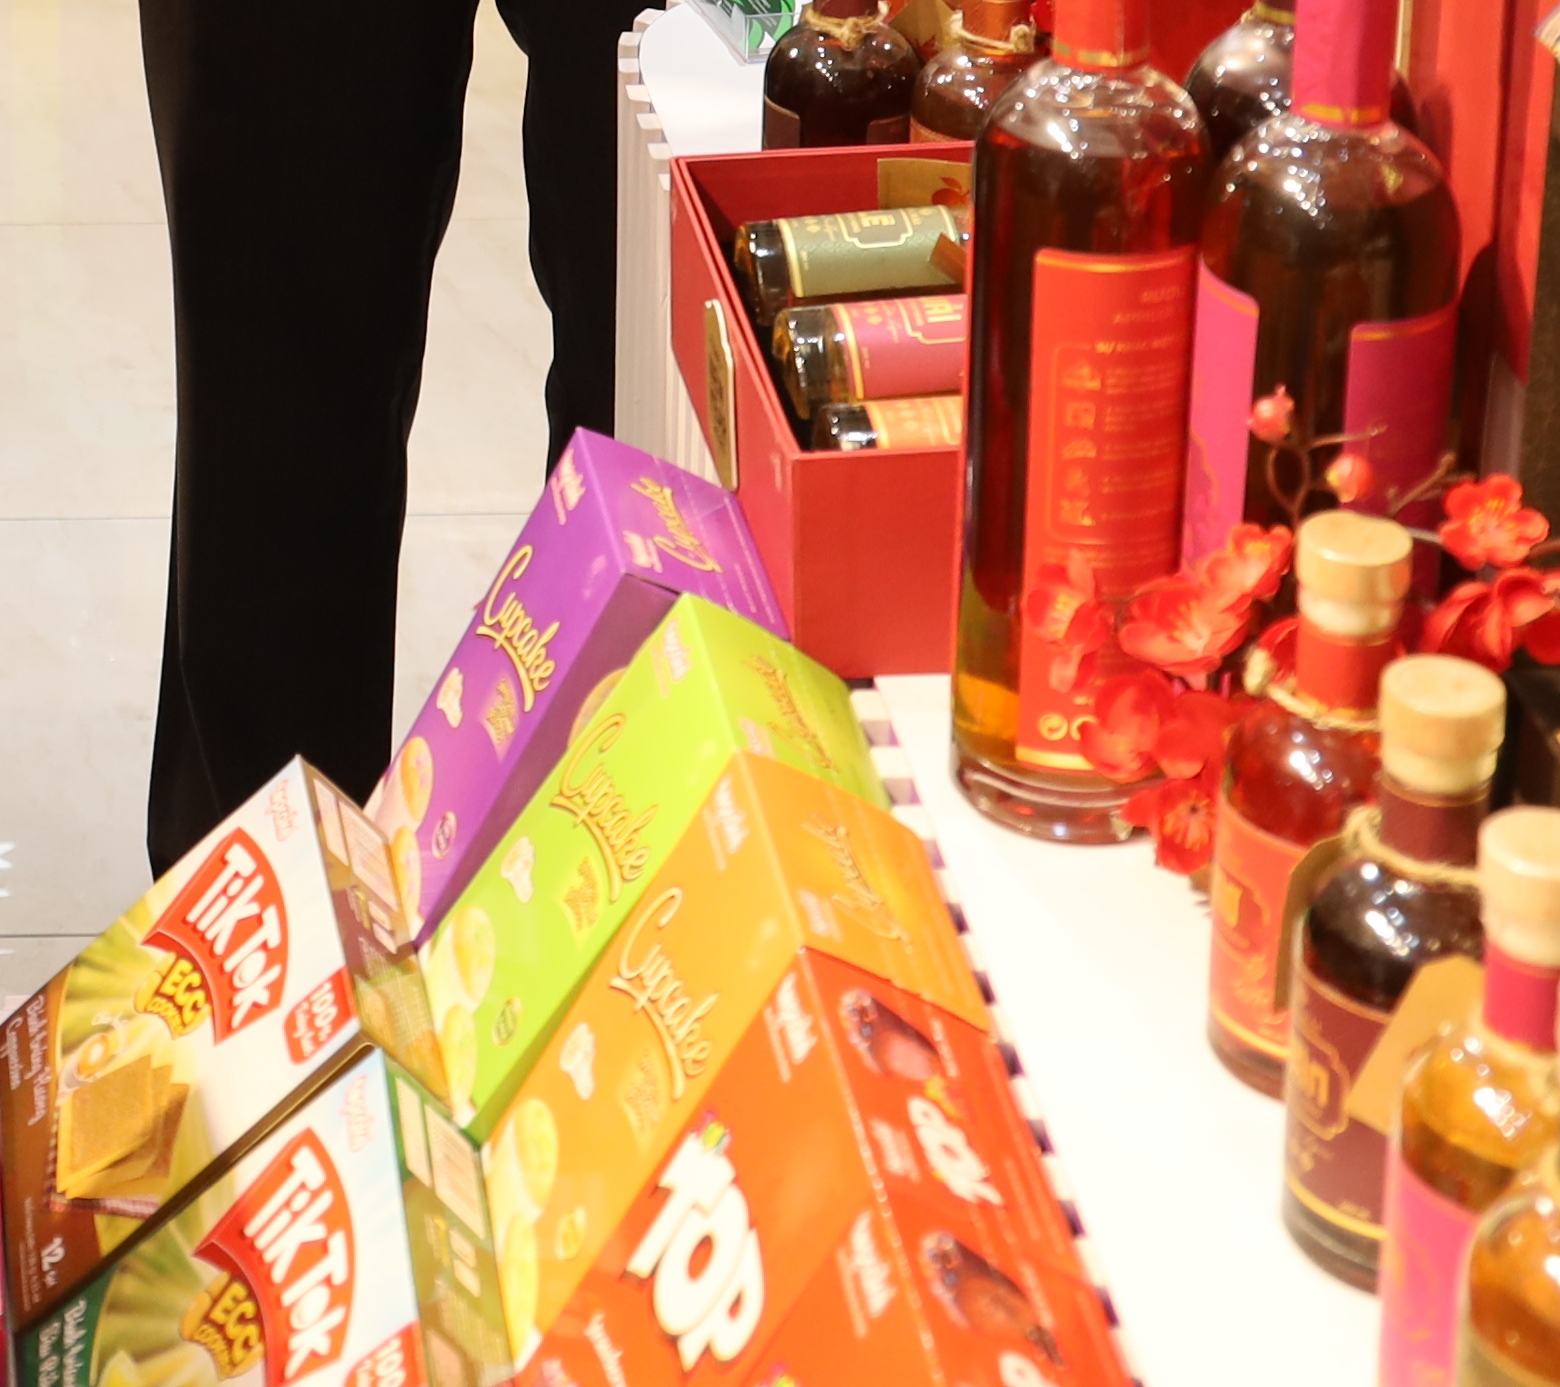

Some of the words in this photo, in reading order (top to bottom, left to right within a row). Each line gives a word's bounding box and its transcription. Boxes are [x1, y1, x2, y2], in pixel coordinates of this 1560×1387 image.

[480, 544, 560, 692] Cupcake
[559, 713, 659, 881] Cupcake
[618, 886, 720, 1078] Cupcake
[40, 1237, 65, 1272] 12
